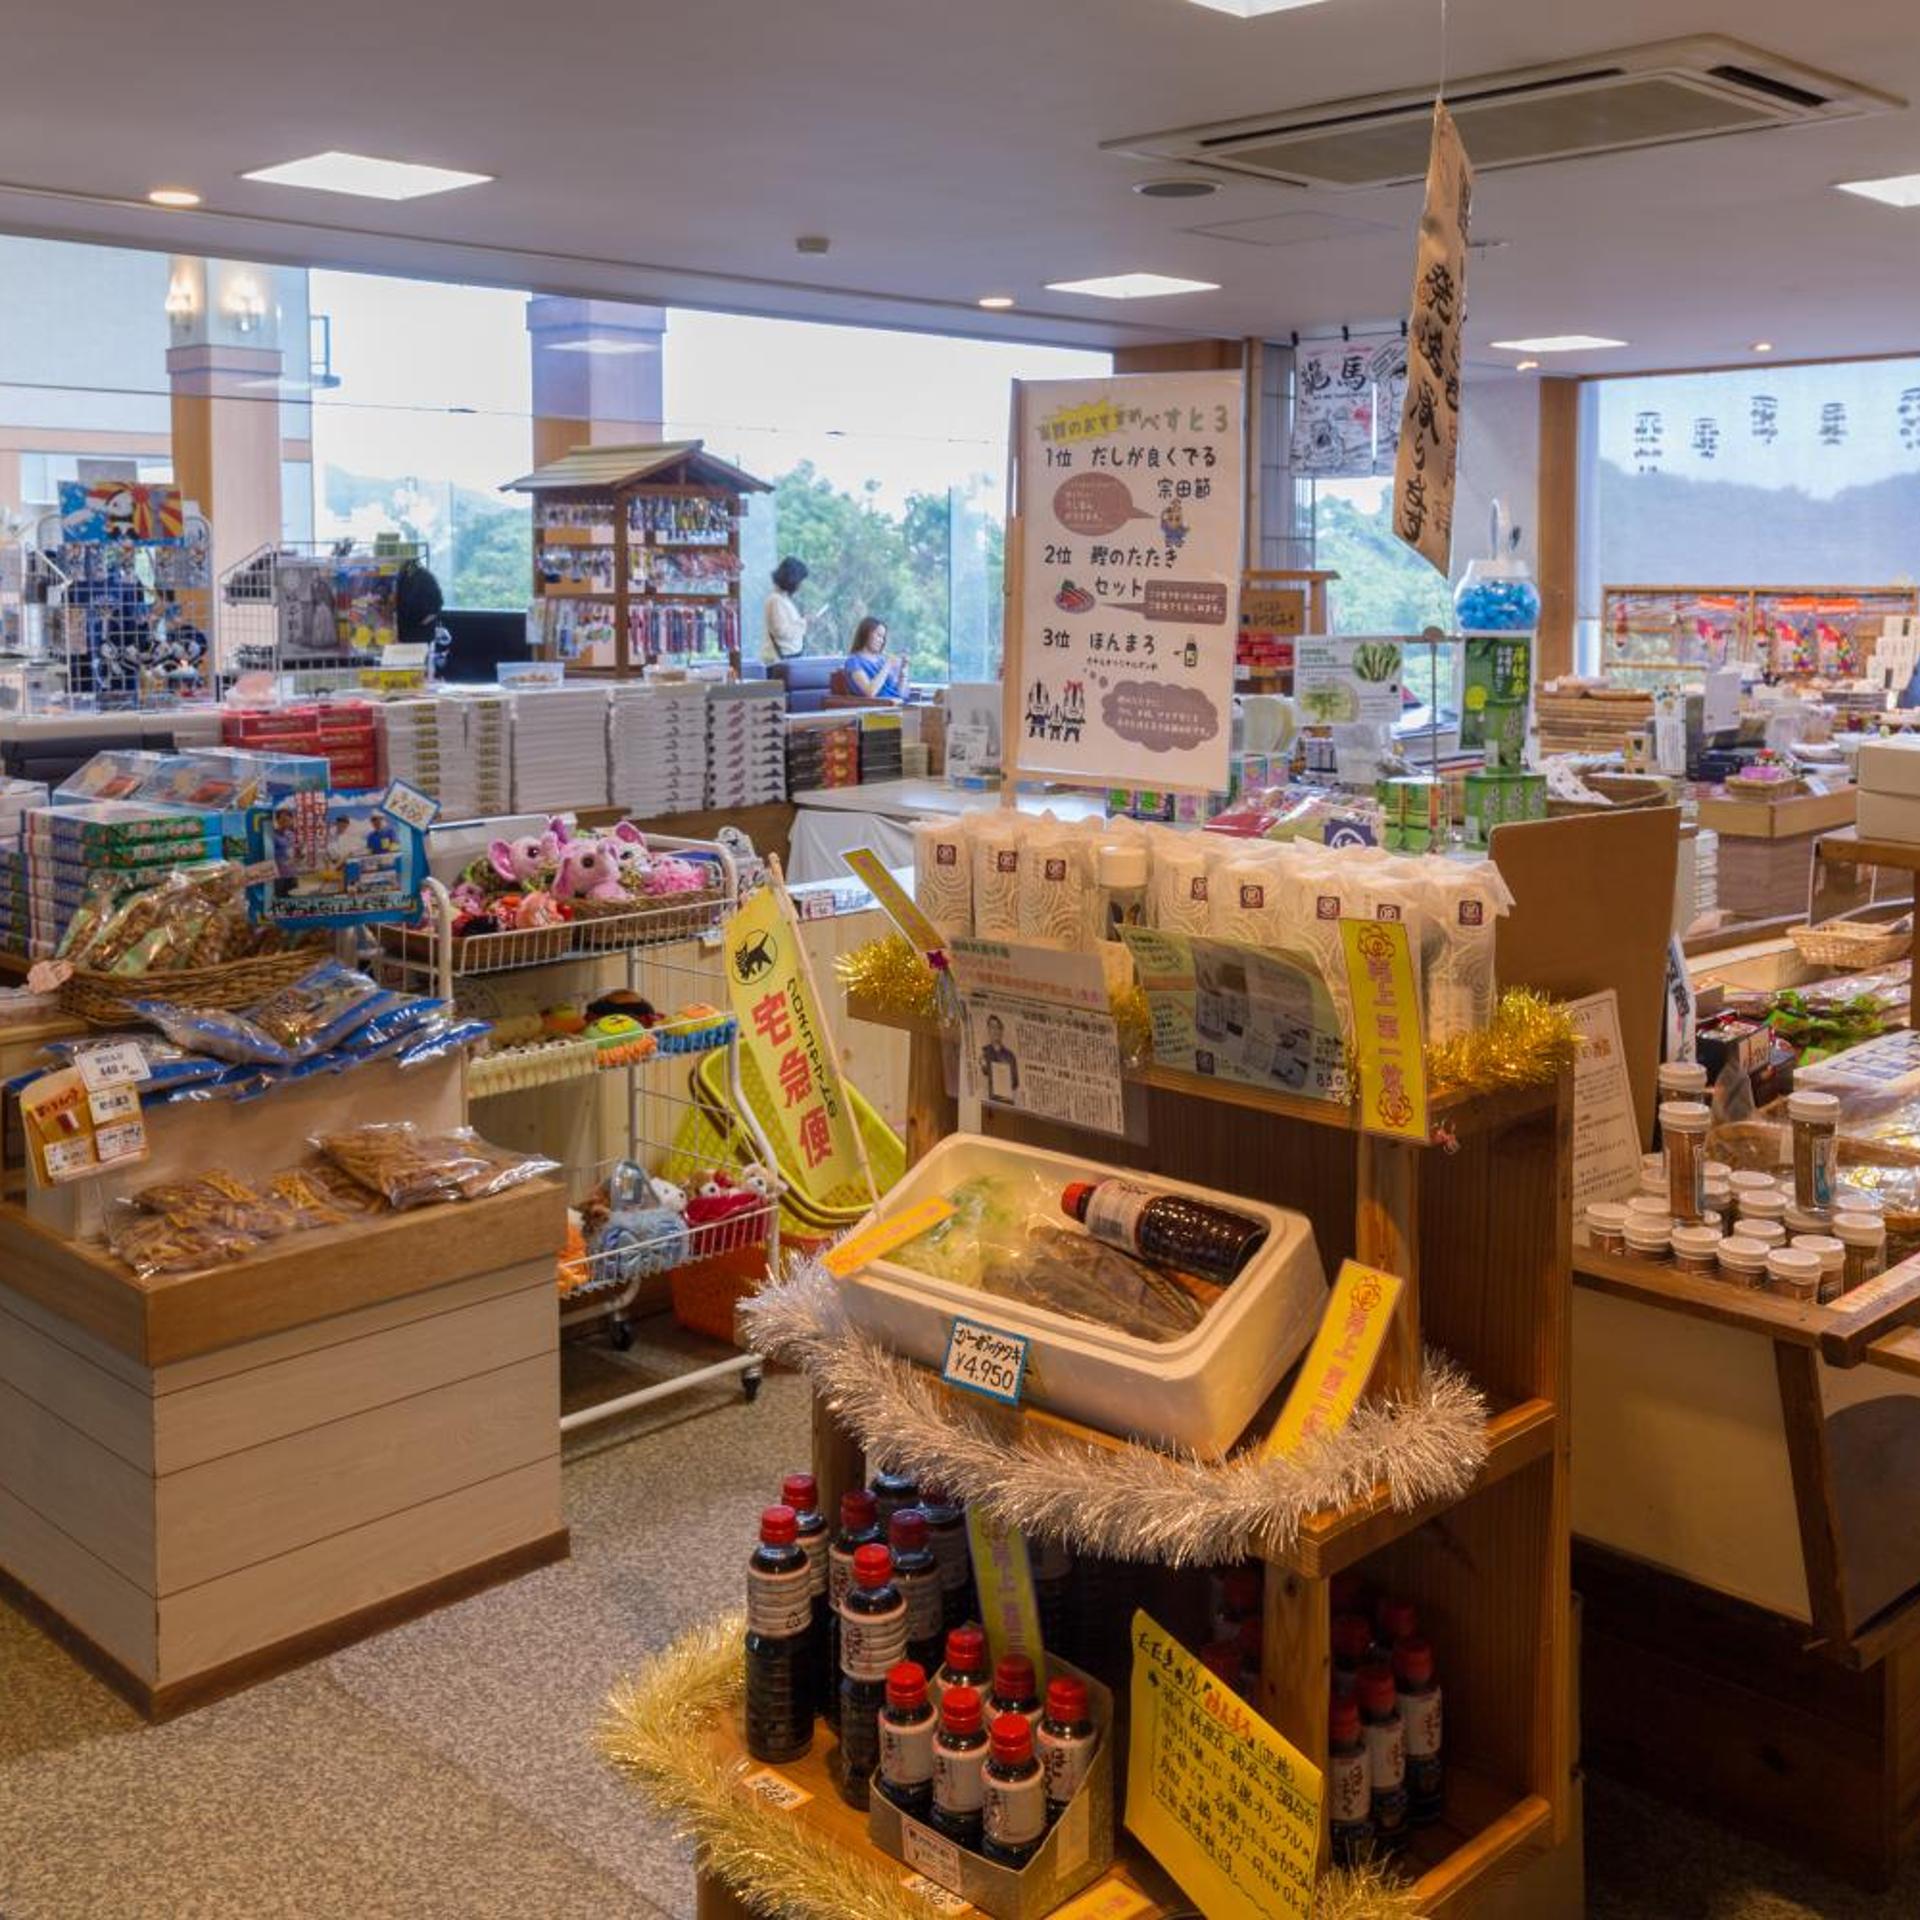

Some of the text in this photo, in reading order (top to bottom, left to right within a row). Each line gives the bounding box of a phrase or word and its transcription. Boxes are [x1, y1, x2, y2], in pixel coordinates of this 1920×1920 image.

[1046, 446, 1217, 468] 1位 だしが良くでる
[1156, 477, 1212, 500] 宗田節
[1043, 545, 1178, 569] 2位 鰹のたたき
[1094, 576, 1143, 597] セット
[1042, 628, 1156, 655] 3位 ほんまろ
[751, 990, 833, 1170] 宅急便
